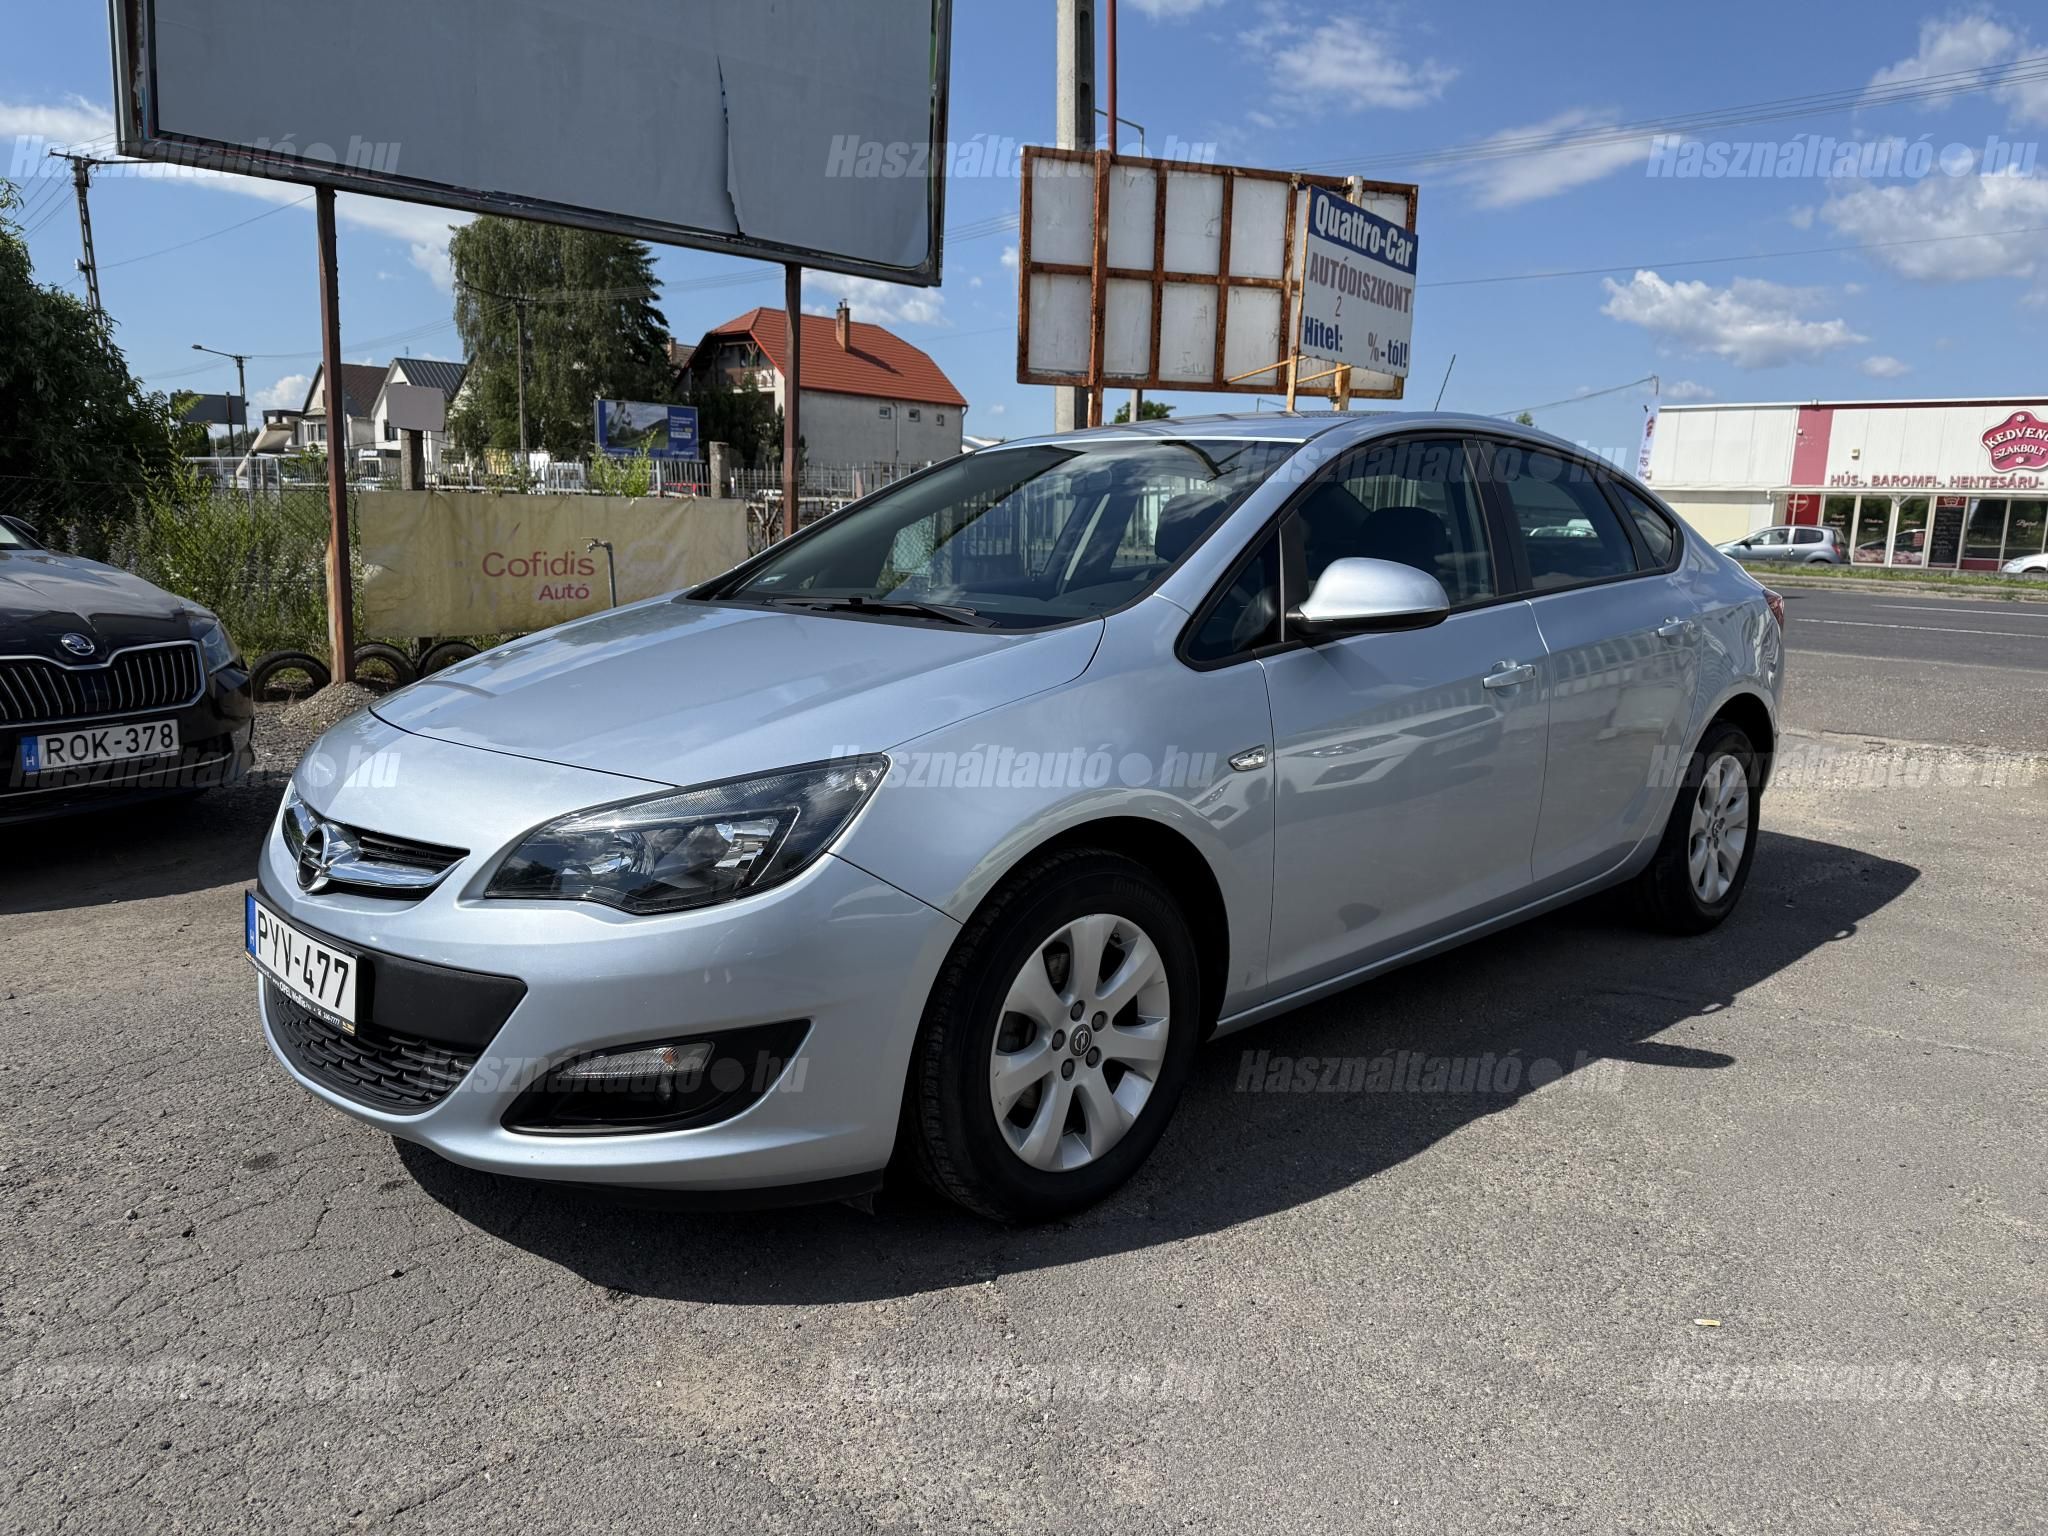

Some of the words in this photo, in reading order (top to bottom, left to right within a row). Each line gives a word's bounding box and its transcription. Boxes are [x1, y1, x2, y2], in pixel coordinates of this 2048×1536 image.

[1315, 194, 1414, 267] Quattro-Car
[1309, 251, 1412, 314] AUTÓDISZKONT
[1303, 315, 1343, 353] Hitel:
[1993, 443, 2047, 460] SZAKBOLT
[482, 550, 596, 578] Cofidis
[538, 583, 590, 601] Autó
[25, 756, 35, 767] H
[45, 722, 174, 766] ROK-378
[258, 908, 349, 1009] PYV-477
